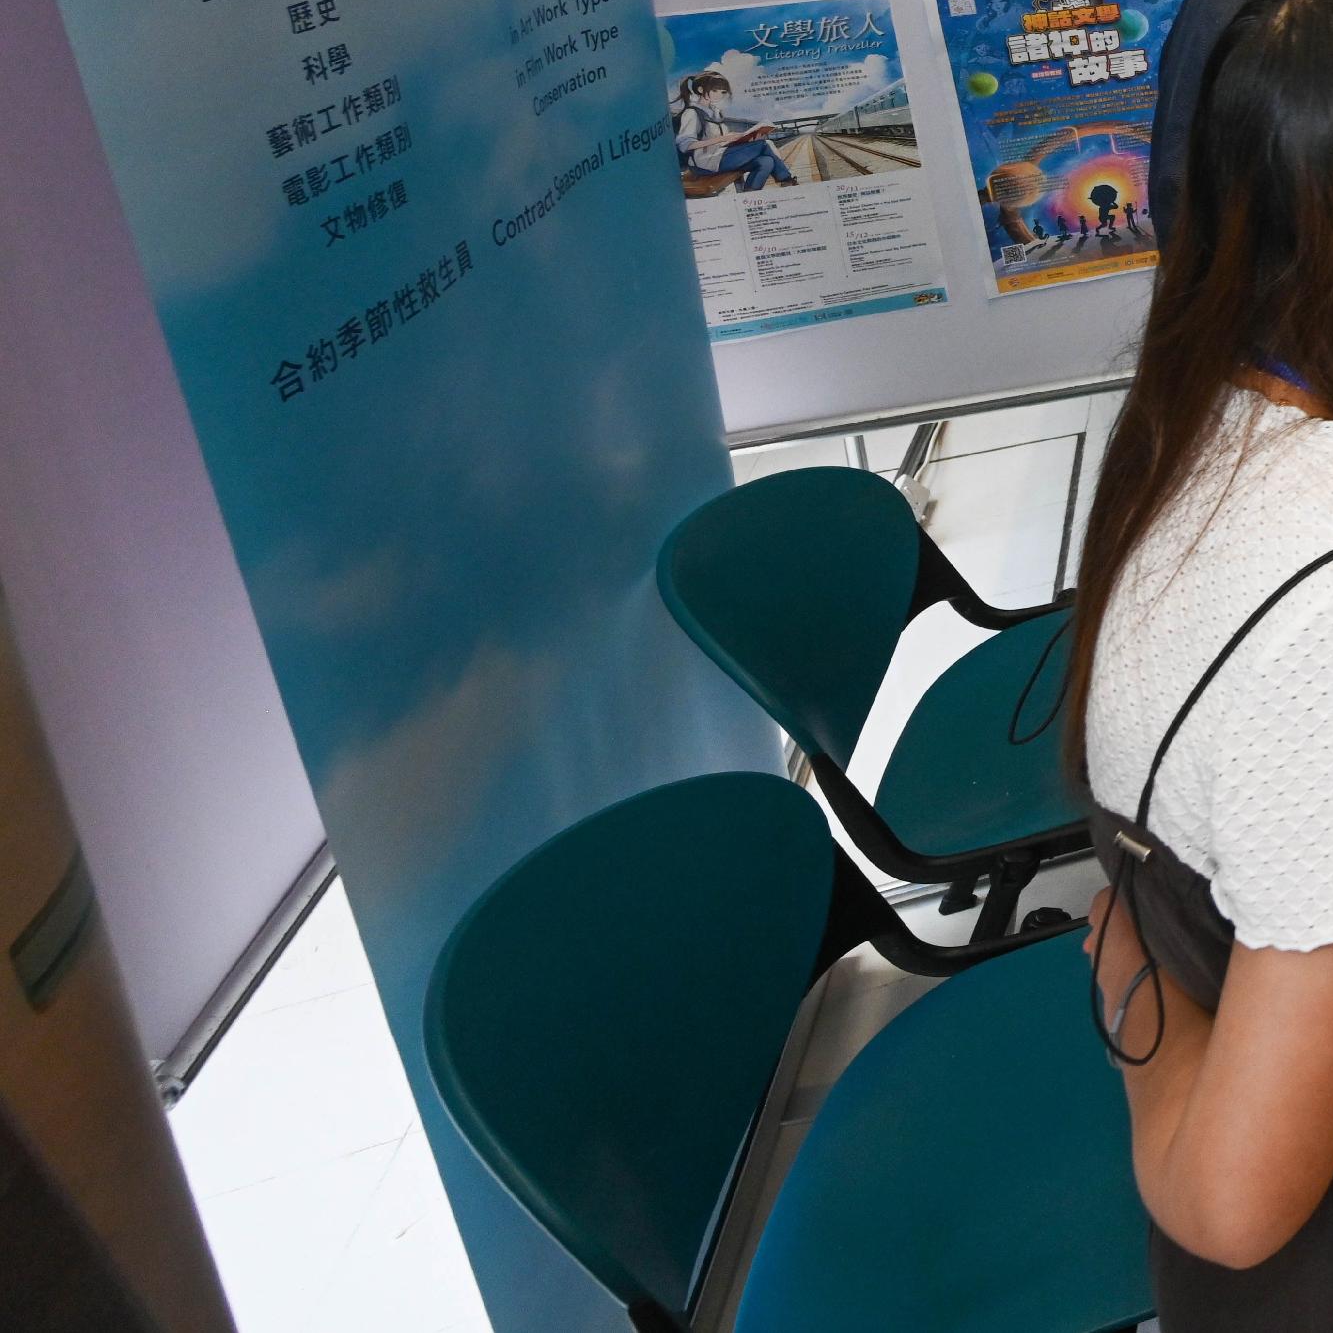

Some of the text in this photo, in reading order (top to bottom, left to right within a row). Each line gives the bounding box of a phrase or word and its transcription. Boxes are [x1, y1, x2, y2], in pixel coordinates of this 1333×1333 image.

[543, 35, 579, 67] Work
[581, 22, 620, 52] Type
[743, 10, 886, 53] 文學旅人
[765, 39, 883, 61] Literary Traveller
[303, 41, 353, 84] 科學
[1066, 48, 1149, 88] 故事
[265, 74, 403, 159] 藝術工作類別
[532, 63, 608, 119] Conservation
[280, 120, 413, 209] 電影工作類別
[322, 178, 410, 248] 文物修復
[491, 184, 556, 248] Contract
[553, 142, 605, 211] Seasonal
[268, 237, 476, 404] 合約季節性救生員
